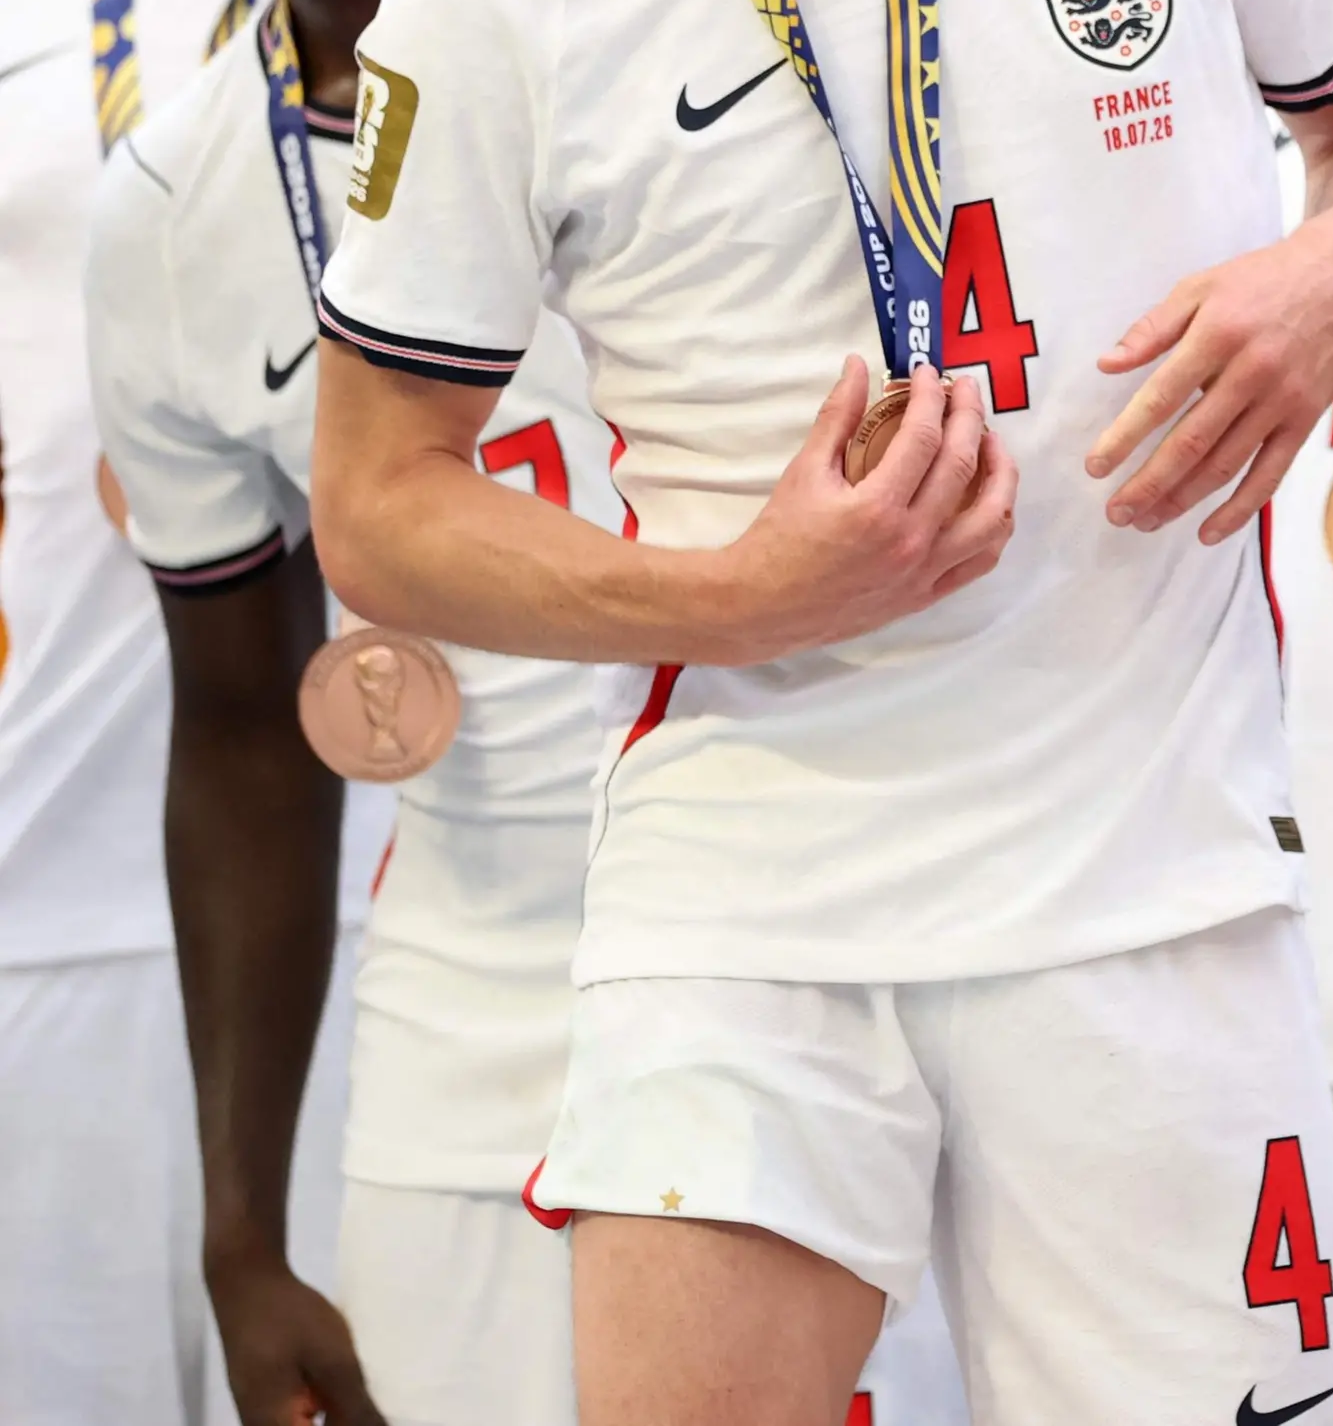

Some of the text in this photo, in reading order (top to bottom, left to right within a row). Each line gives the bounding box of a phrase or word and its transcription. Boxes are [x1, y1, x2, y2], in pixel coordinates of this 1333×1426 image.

[1093, 80, 1173, 121] FRANCE
[1102, 115, 1174, 153] 18.07.26
[869, 232, 896, 293] CUP
[907, 299, 931, 378] 026
[941, 197, 1039, 415] 4
[1243, 1135, 1333, 1352] 4
